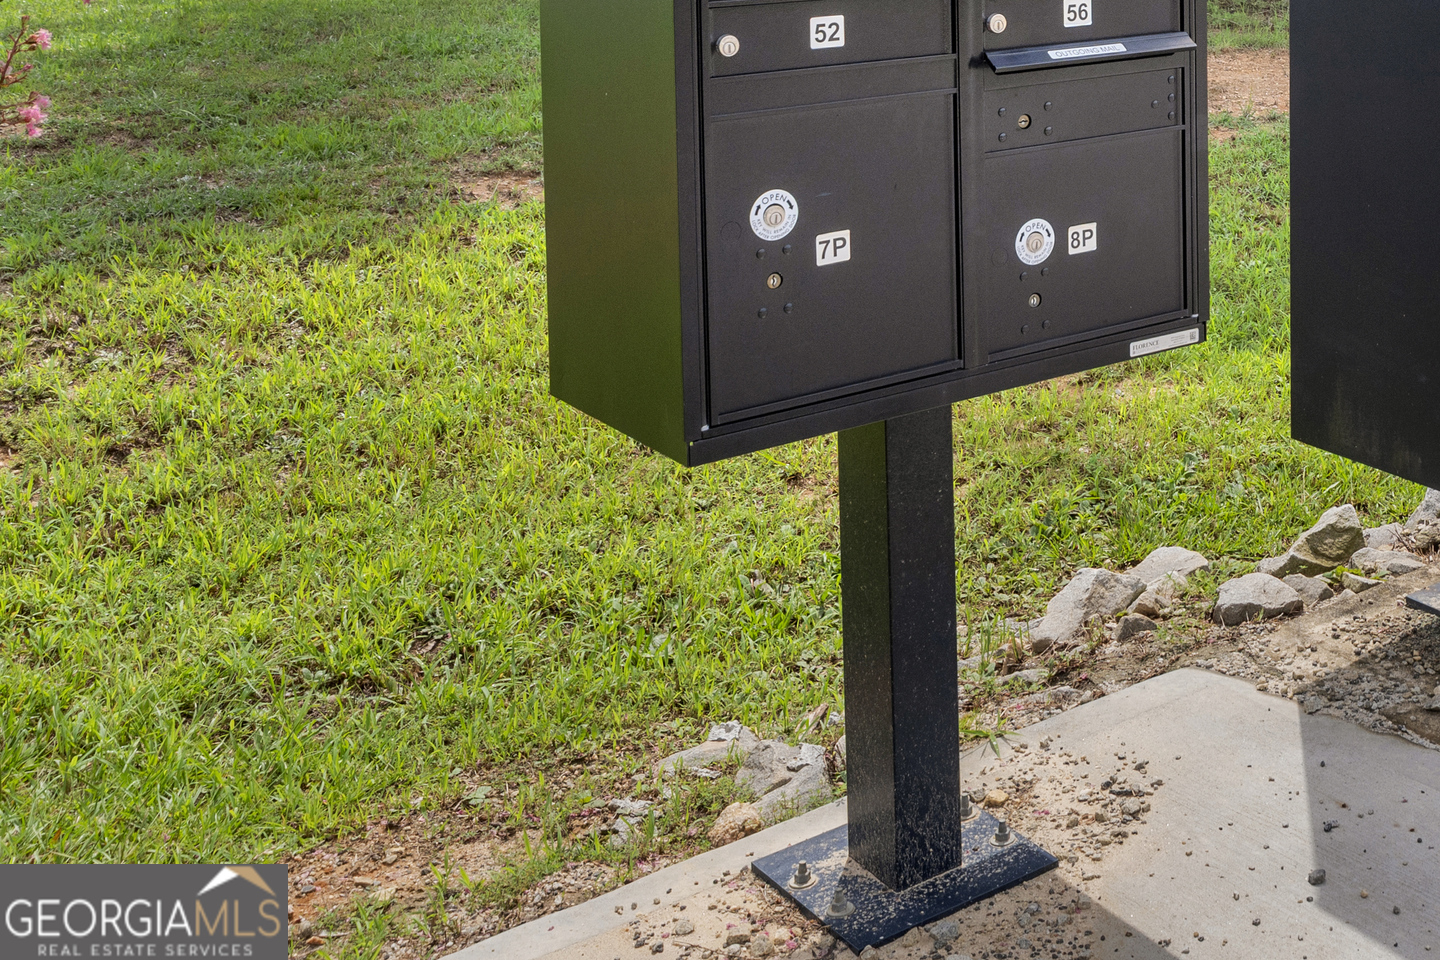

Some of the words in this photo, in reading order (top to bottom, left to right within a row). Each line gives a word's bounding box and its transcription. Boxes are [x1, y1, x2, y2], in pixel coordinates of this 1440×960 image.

[1066, 3, 1089, 22] 56
[814, 22, 840, 43] 52
[1055, 47, 1100, 58] OUTGOING
[762, 193, 788, 204] OPEN
[1026, 222, 1046, 232] OPEN
[1070, 229, 1094, 248] 8P
[818, 237, 846, 260] 7P
[1132, 340, 1159, 350] FLORENCE
